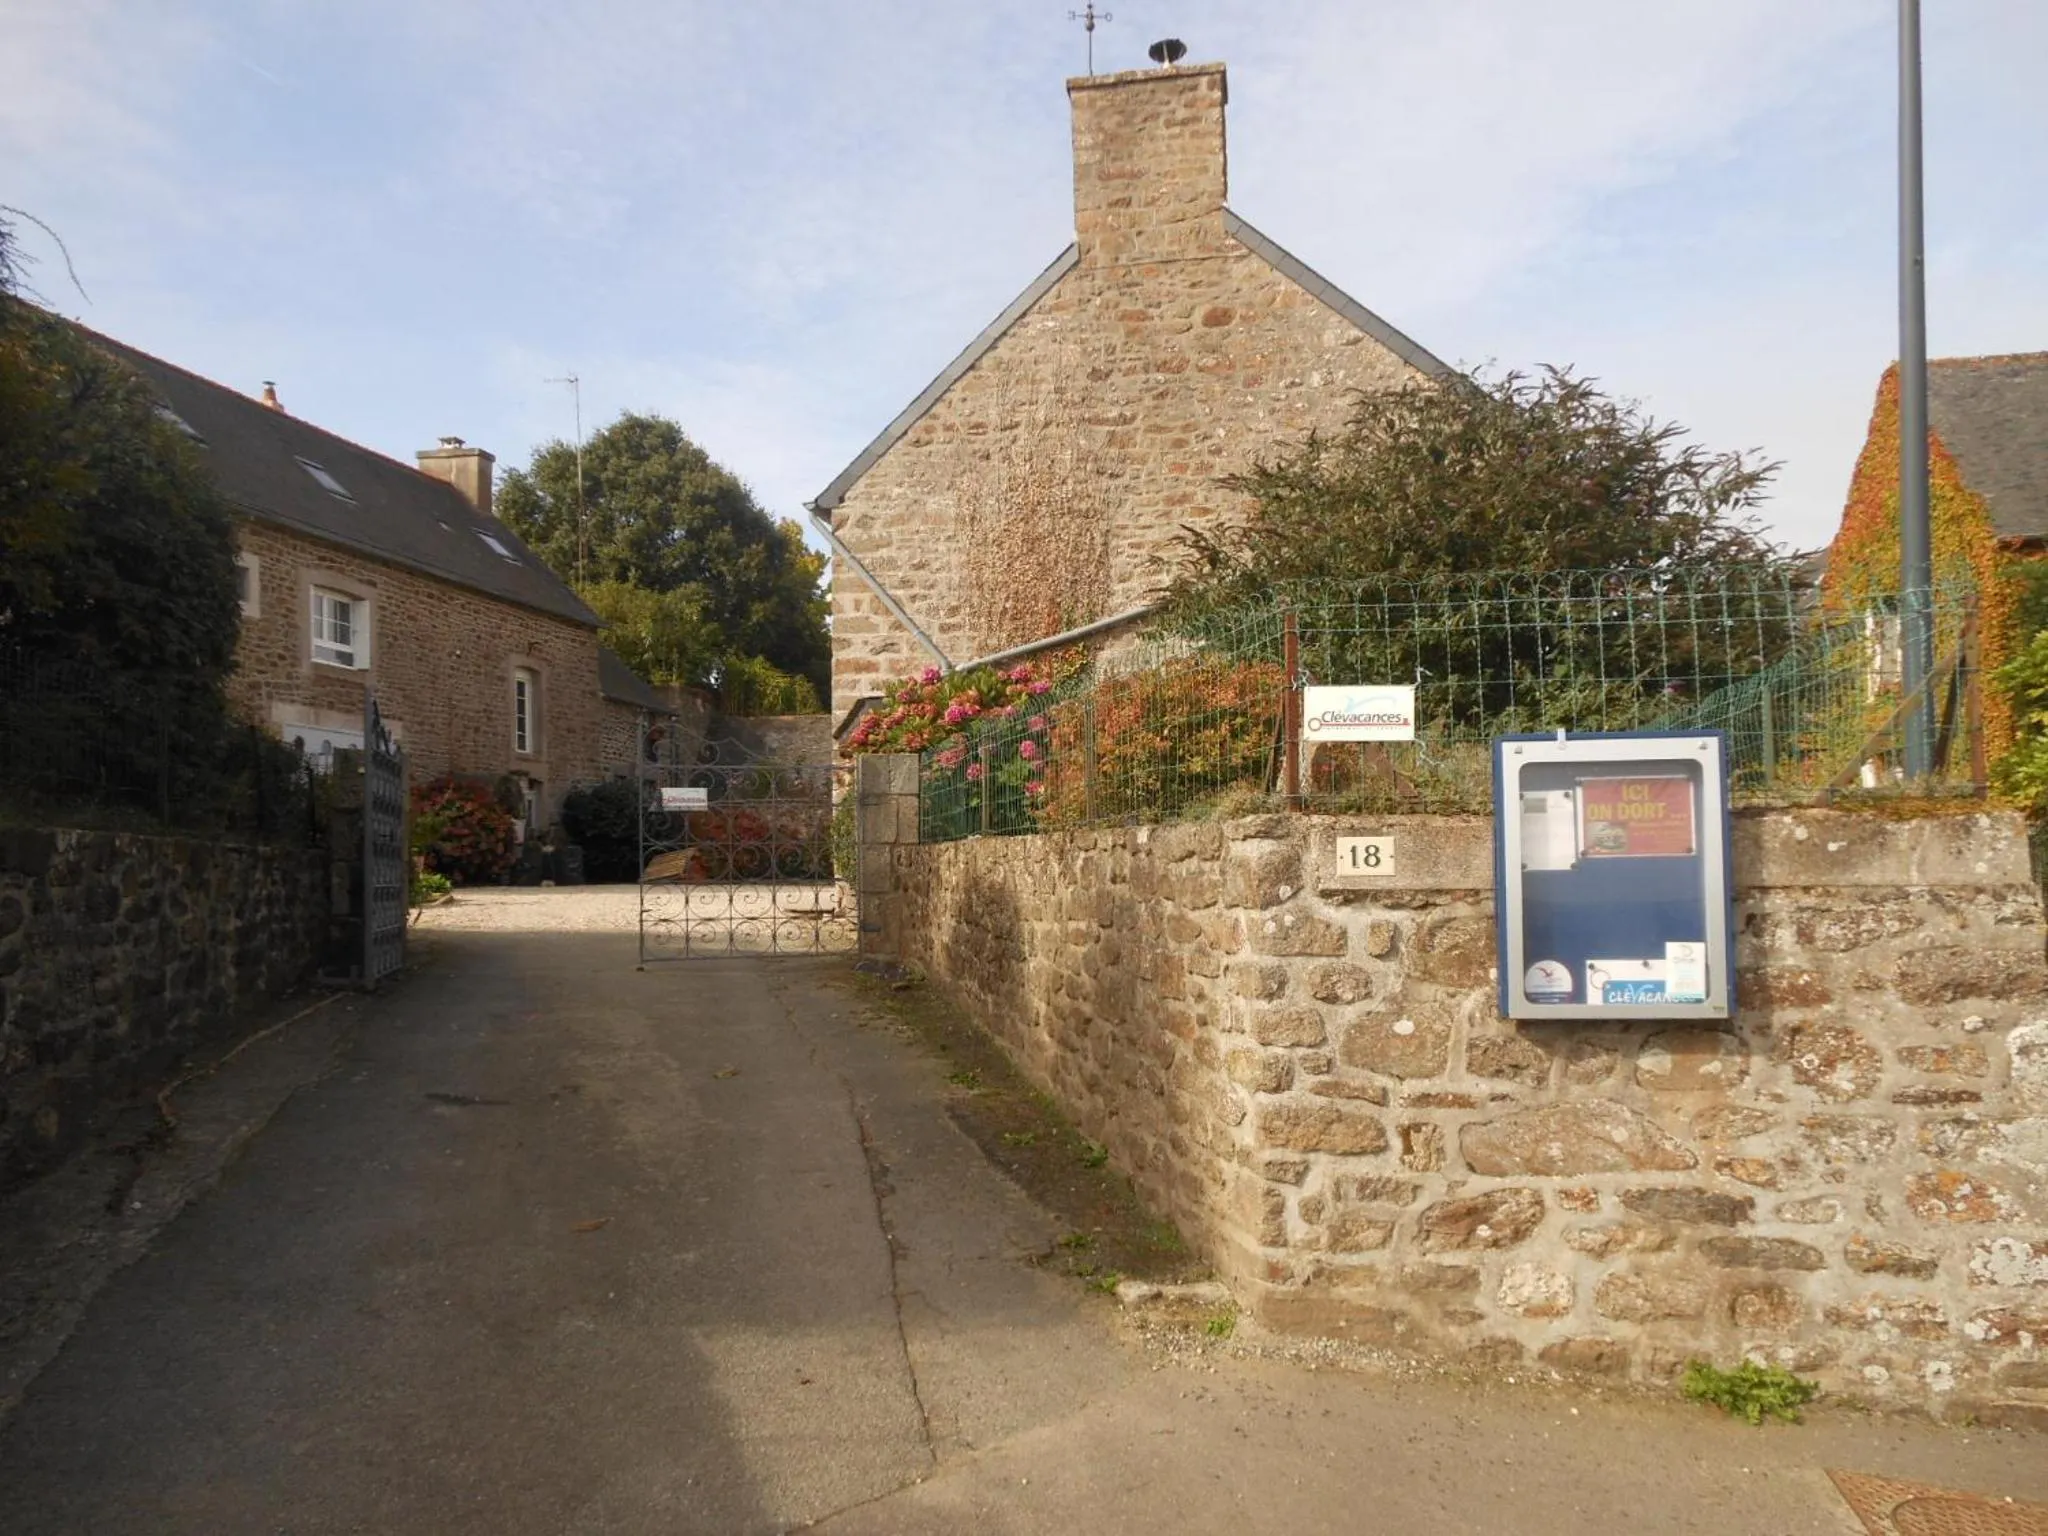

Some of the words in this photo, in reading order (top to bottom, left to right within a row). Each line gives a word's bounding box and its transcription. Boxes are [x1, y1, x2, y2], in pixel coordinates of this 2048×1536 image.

[1321, 710, 1402, 723] Clévacances
[1623, 784, 1649, 801] ICI
[1587, 802, 1613, 820] ON
[1617, 802, 1667, 820] DORT
[1350, 844, 1381, 868] 18
